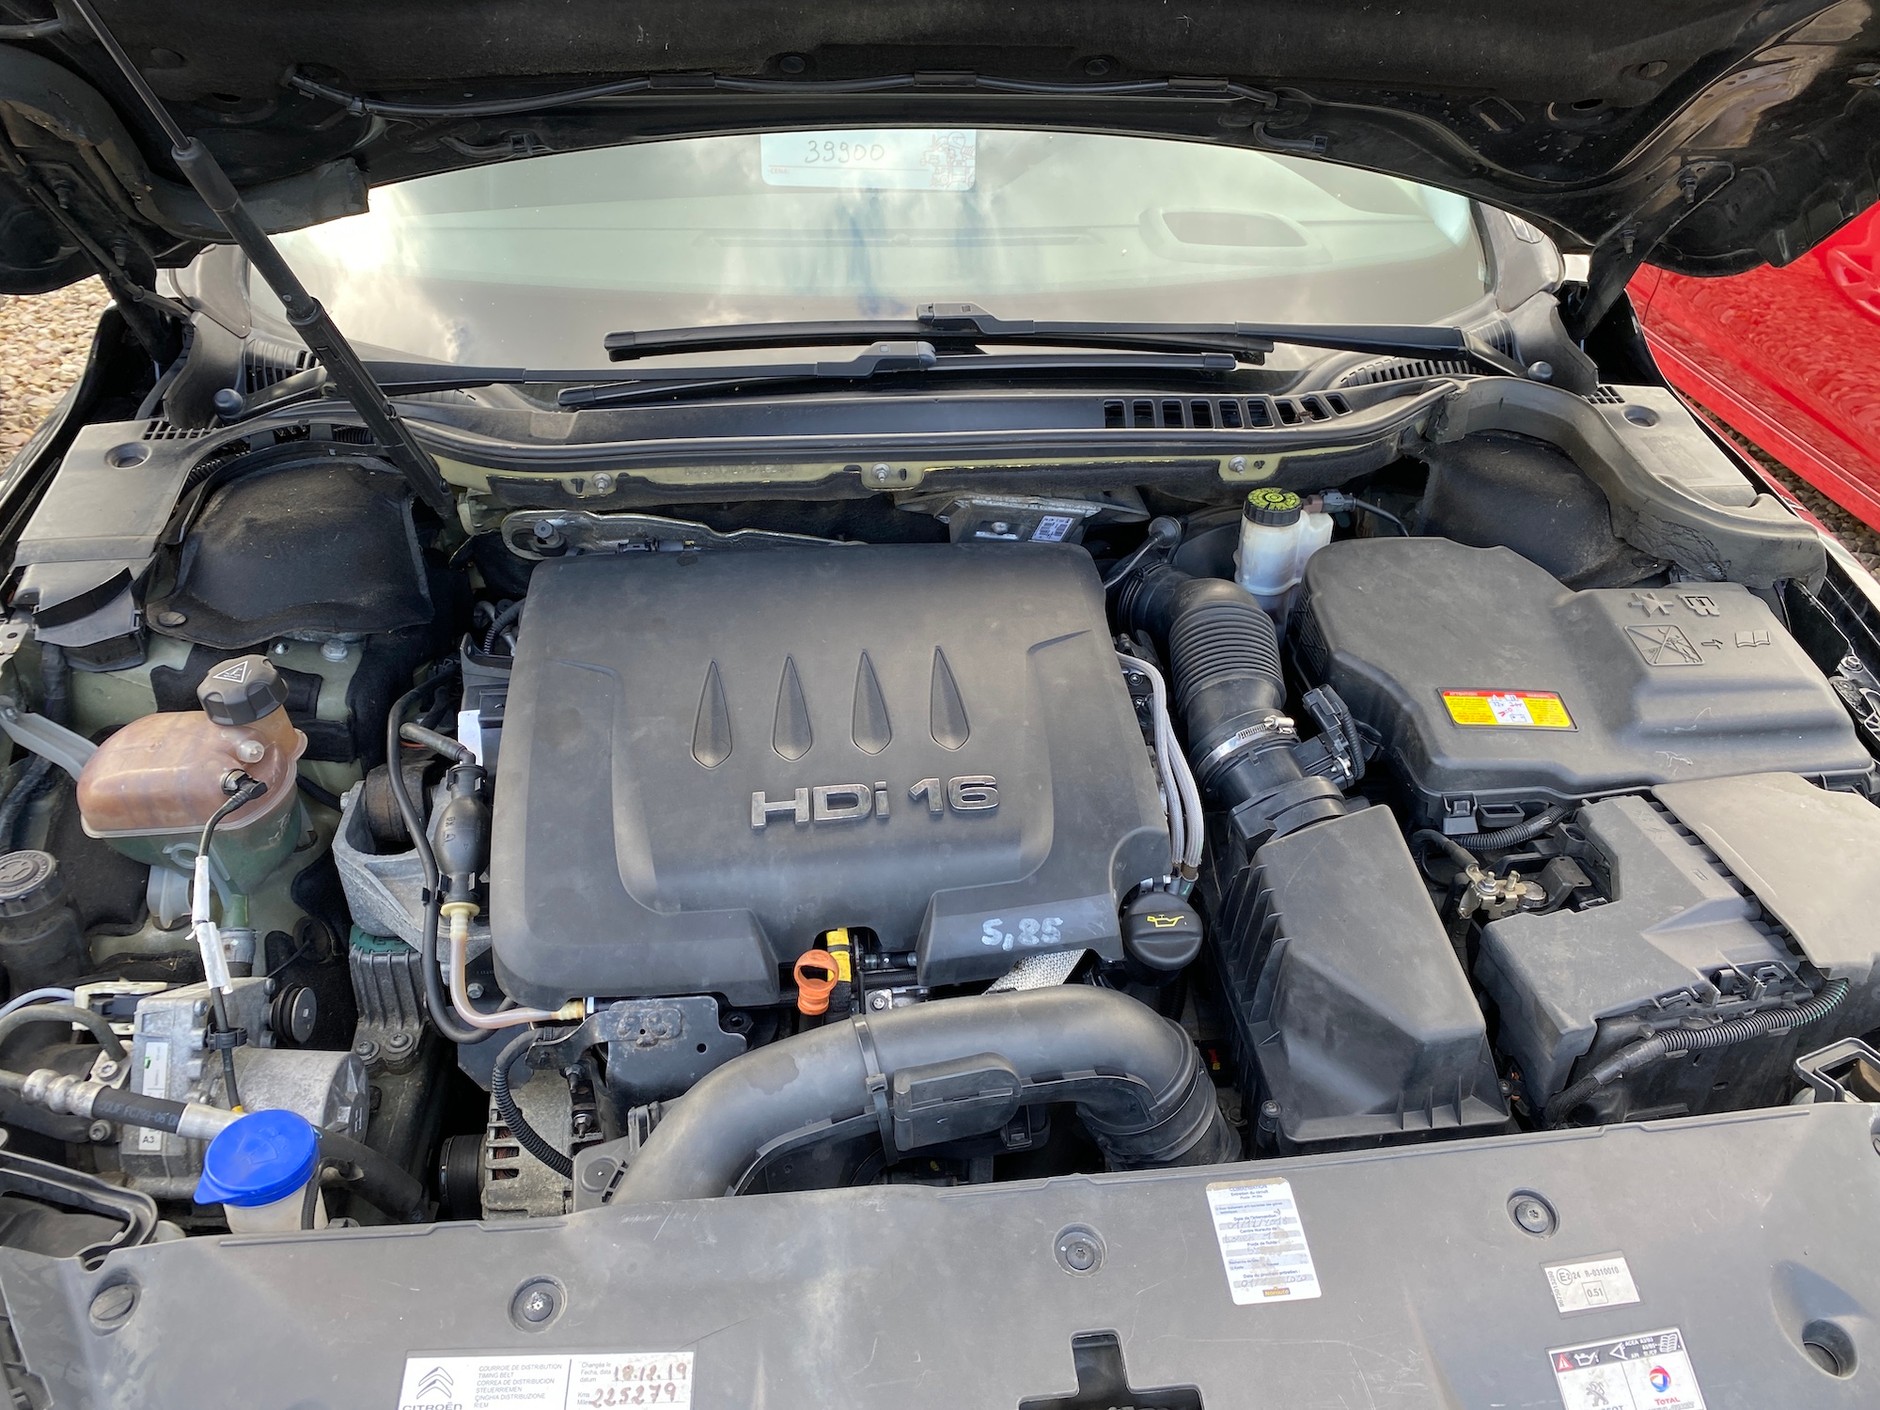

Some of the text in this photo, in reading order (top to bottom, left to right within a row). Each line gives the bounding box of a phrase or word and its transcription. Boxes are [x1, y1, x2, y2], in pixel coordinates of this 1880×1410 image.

[804, 139, 885, 164] 39900
[751, 774, 1000, 829] HDi 16
[1587, 1287, 1603, 1298] 0.51
[478, 1364, 510, 1372] COURROIE
[521, 1363, 562, 1371] DISTRIBUTION
